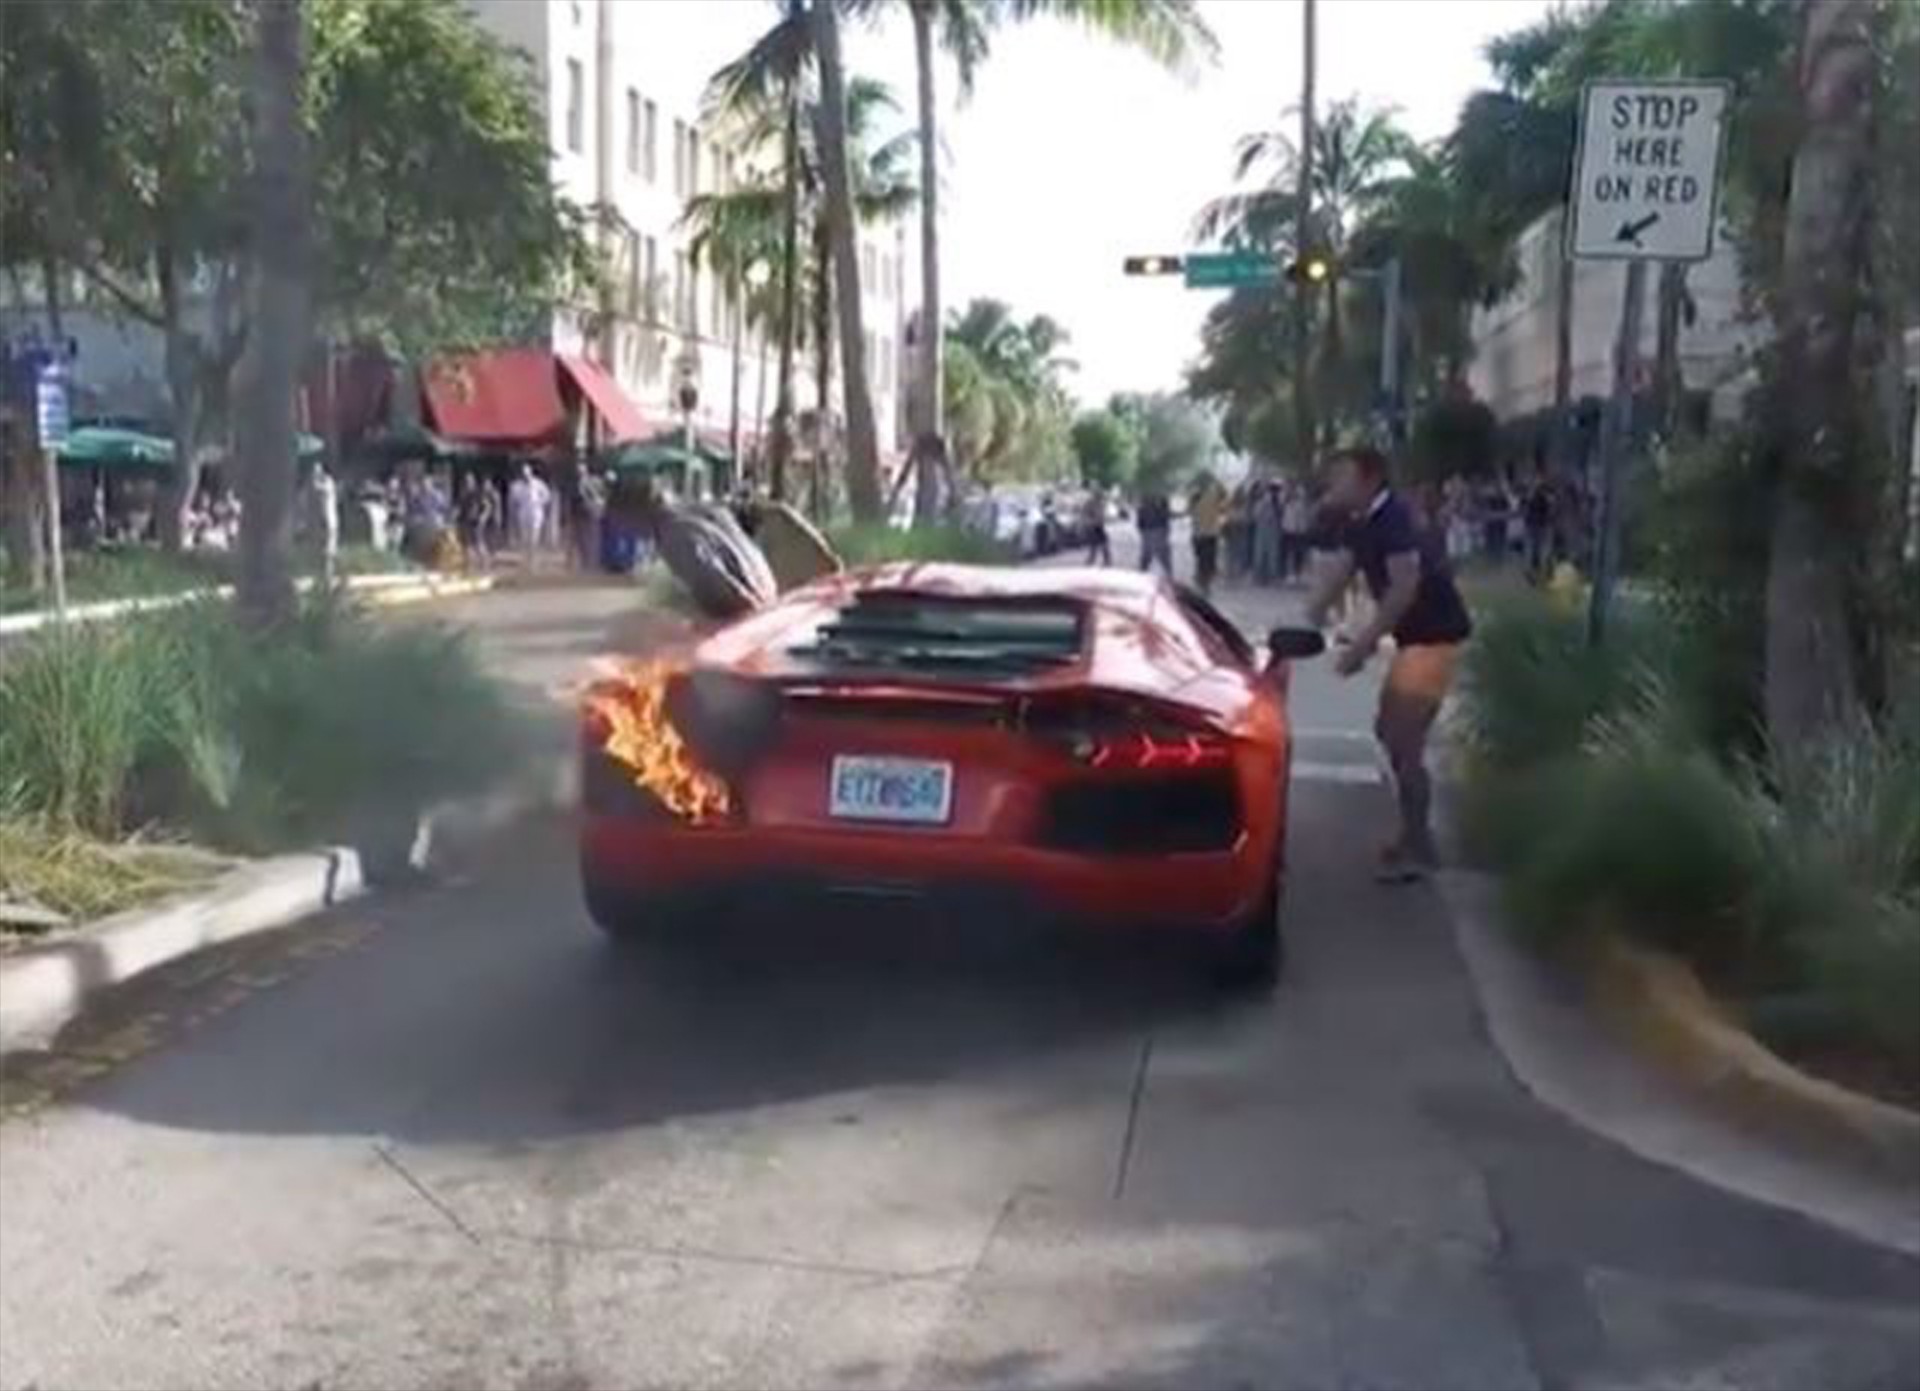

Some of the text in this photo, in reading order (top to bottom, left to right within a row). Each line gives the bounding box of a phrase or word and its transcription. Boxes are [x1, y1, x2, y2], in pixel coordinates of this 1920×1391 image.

[1612, 95, 1698, 129] STOP
[1615, 138, 1683, 167] HERE
[1595, 174, 1698, 203] ON RED
